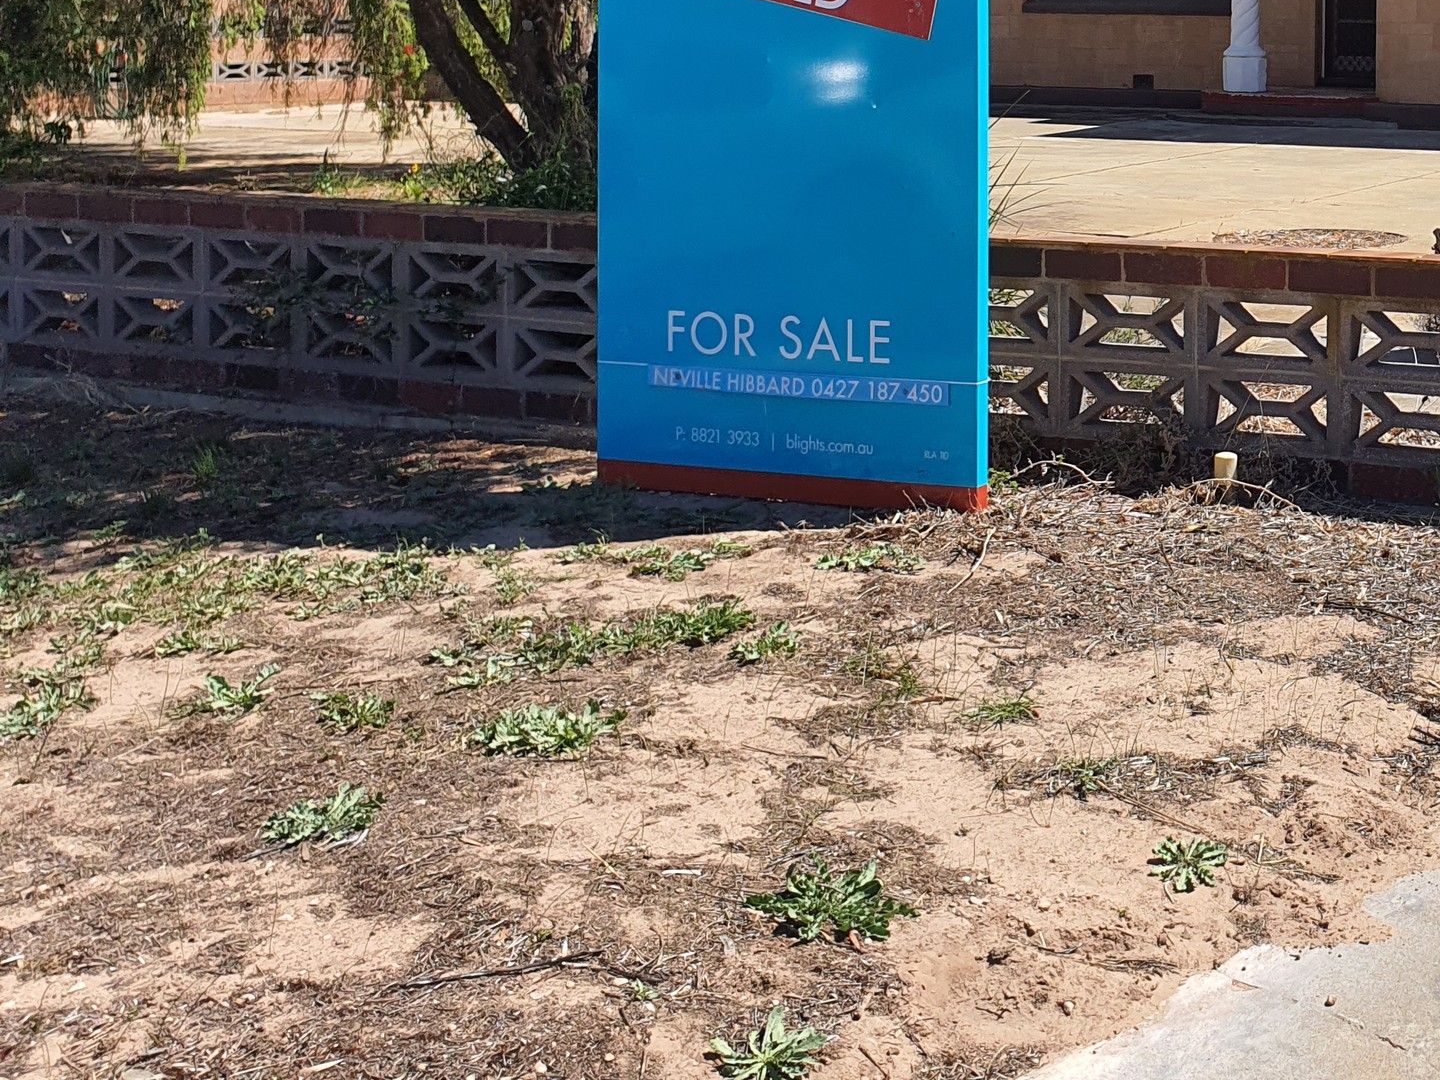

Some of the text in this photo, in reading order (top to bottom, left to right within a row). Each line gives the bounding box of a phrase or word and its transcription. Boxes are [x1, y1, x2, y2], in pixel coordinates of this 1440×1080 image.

[667, 310, 891, 364] FOR SALE
[653, 367, 943, 403] NEVILLE HIBBARD 0427 187 450
[691, 427, 720, 444] 8821
[727, 430, 760, 447] 3933
[786, 433, 874, 455] blights.com.au
